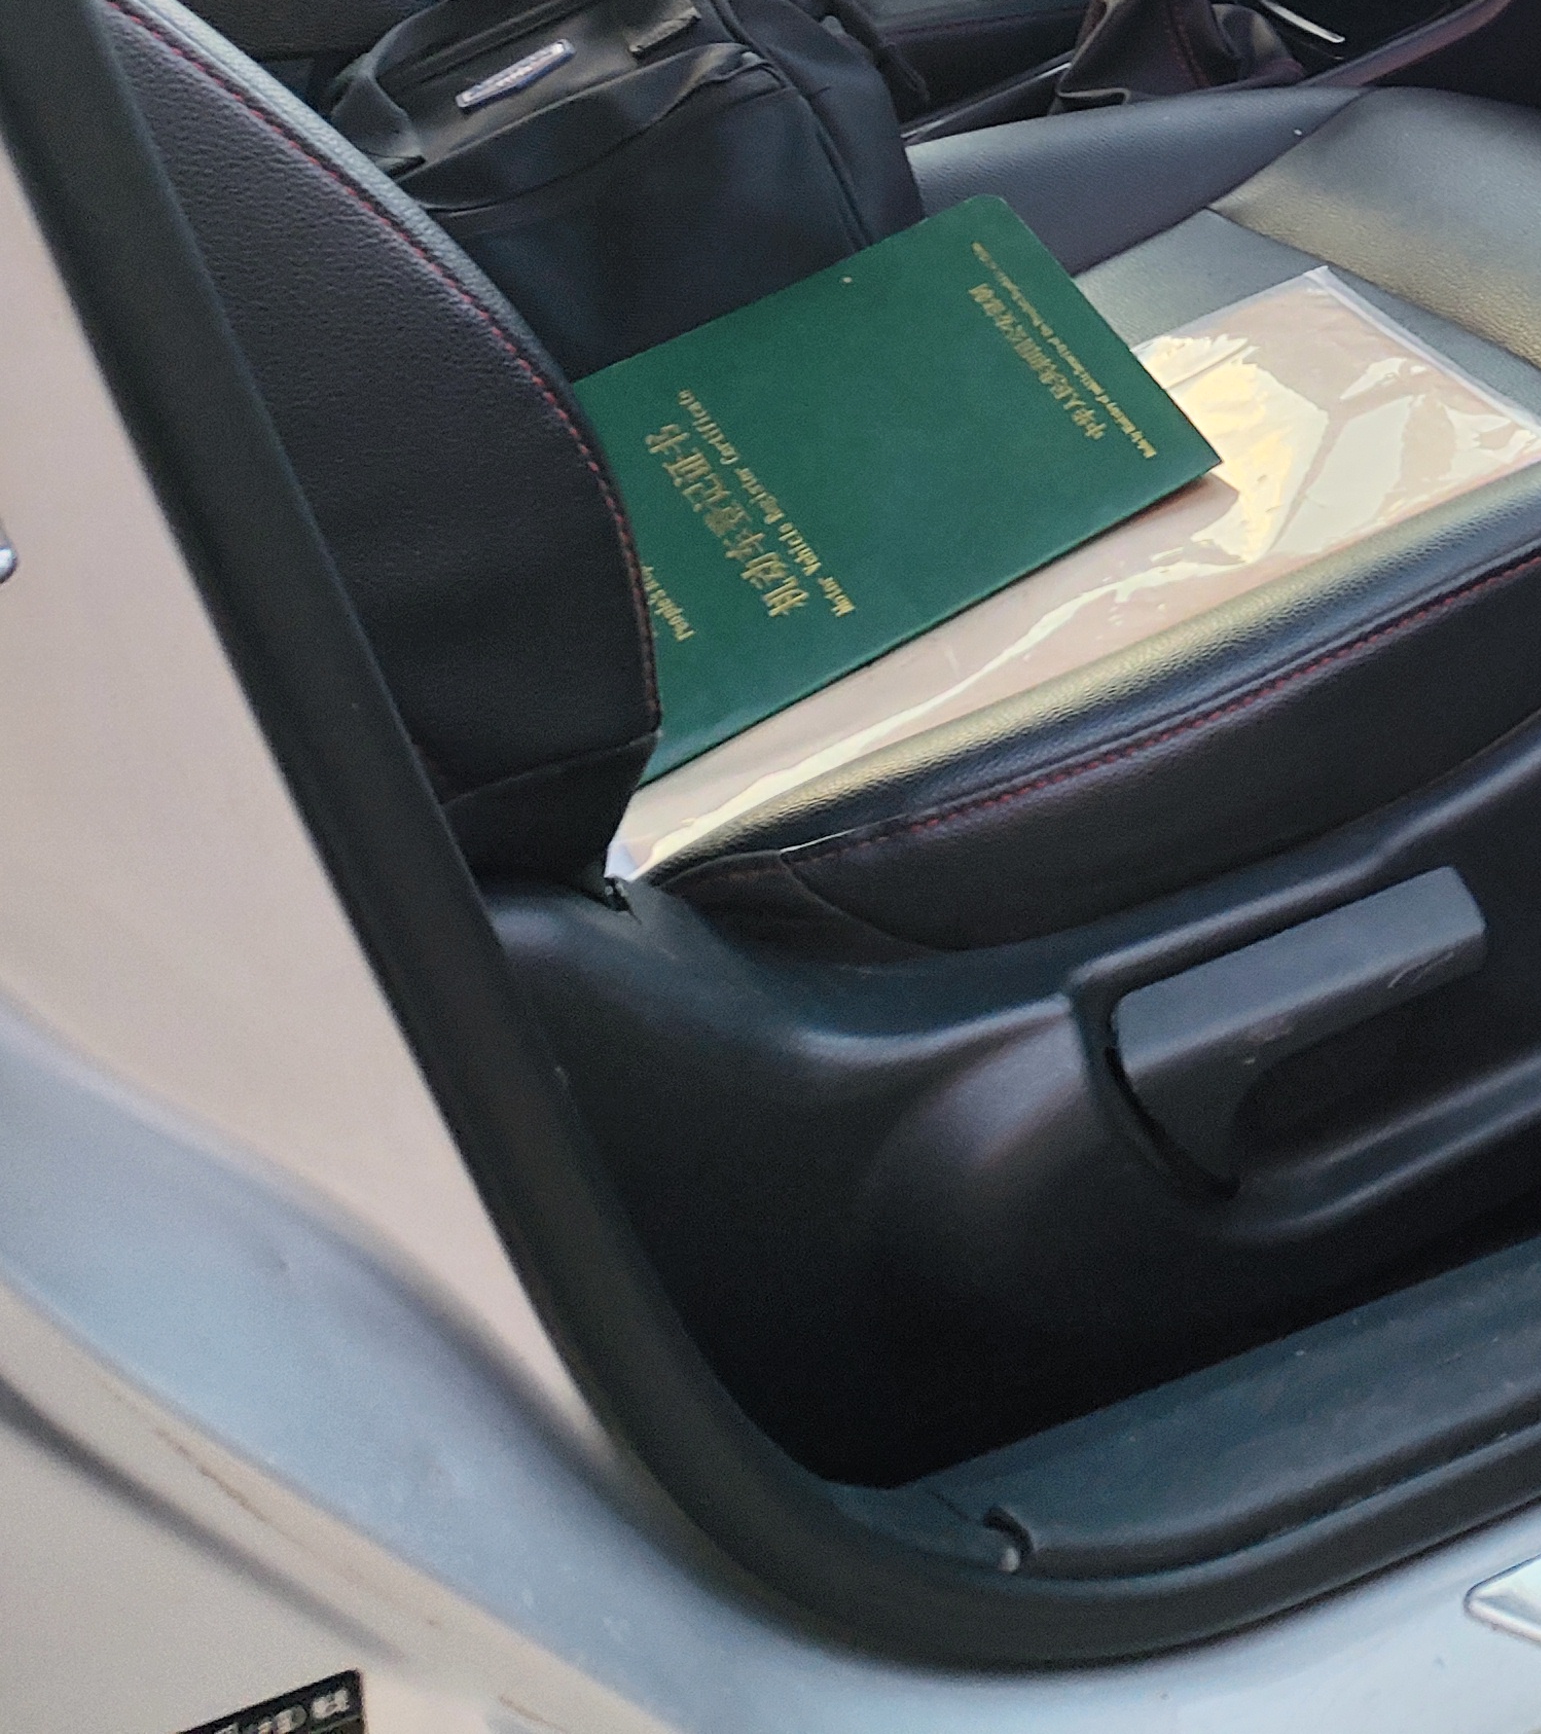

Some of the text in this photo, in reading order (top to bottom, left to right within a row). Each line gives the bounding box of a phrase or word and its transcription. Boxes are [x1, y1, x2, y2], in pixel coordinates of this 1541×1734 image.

[676, 389, 739, 466] Certificate
[645, 423, 810, 618] 机动车登记证书
[778, 521, 822, 576] Vehicle
[817, 576, 856, 618] Motor
